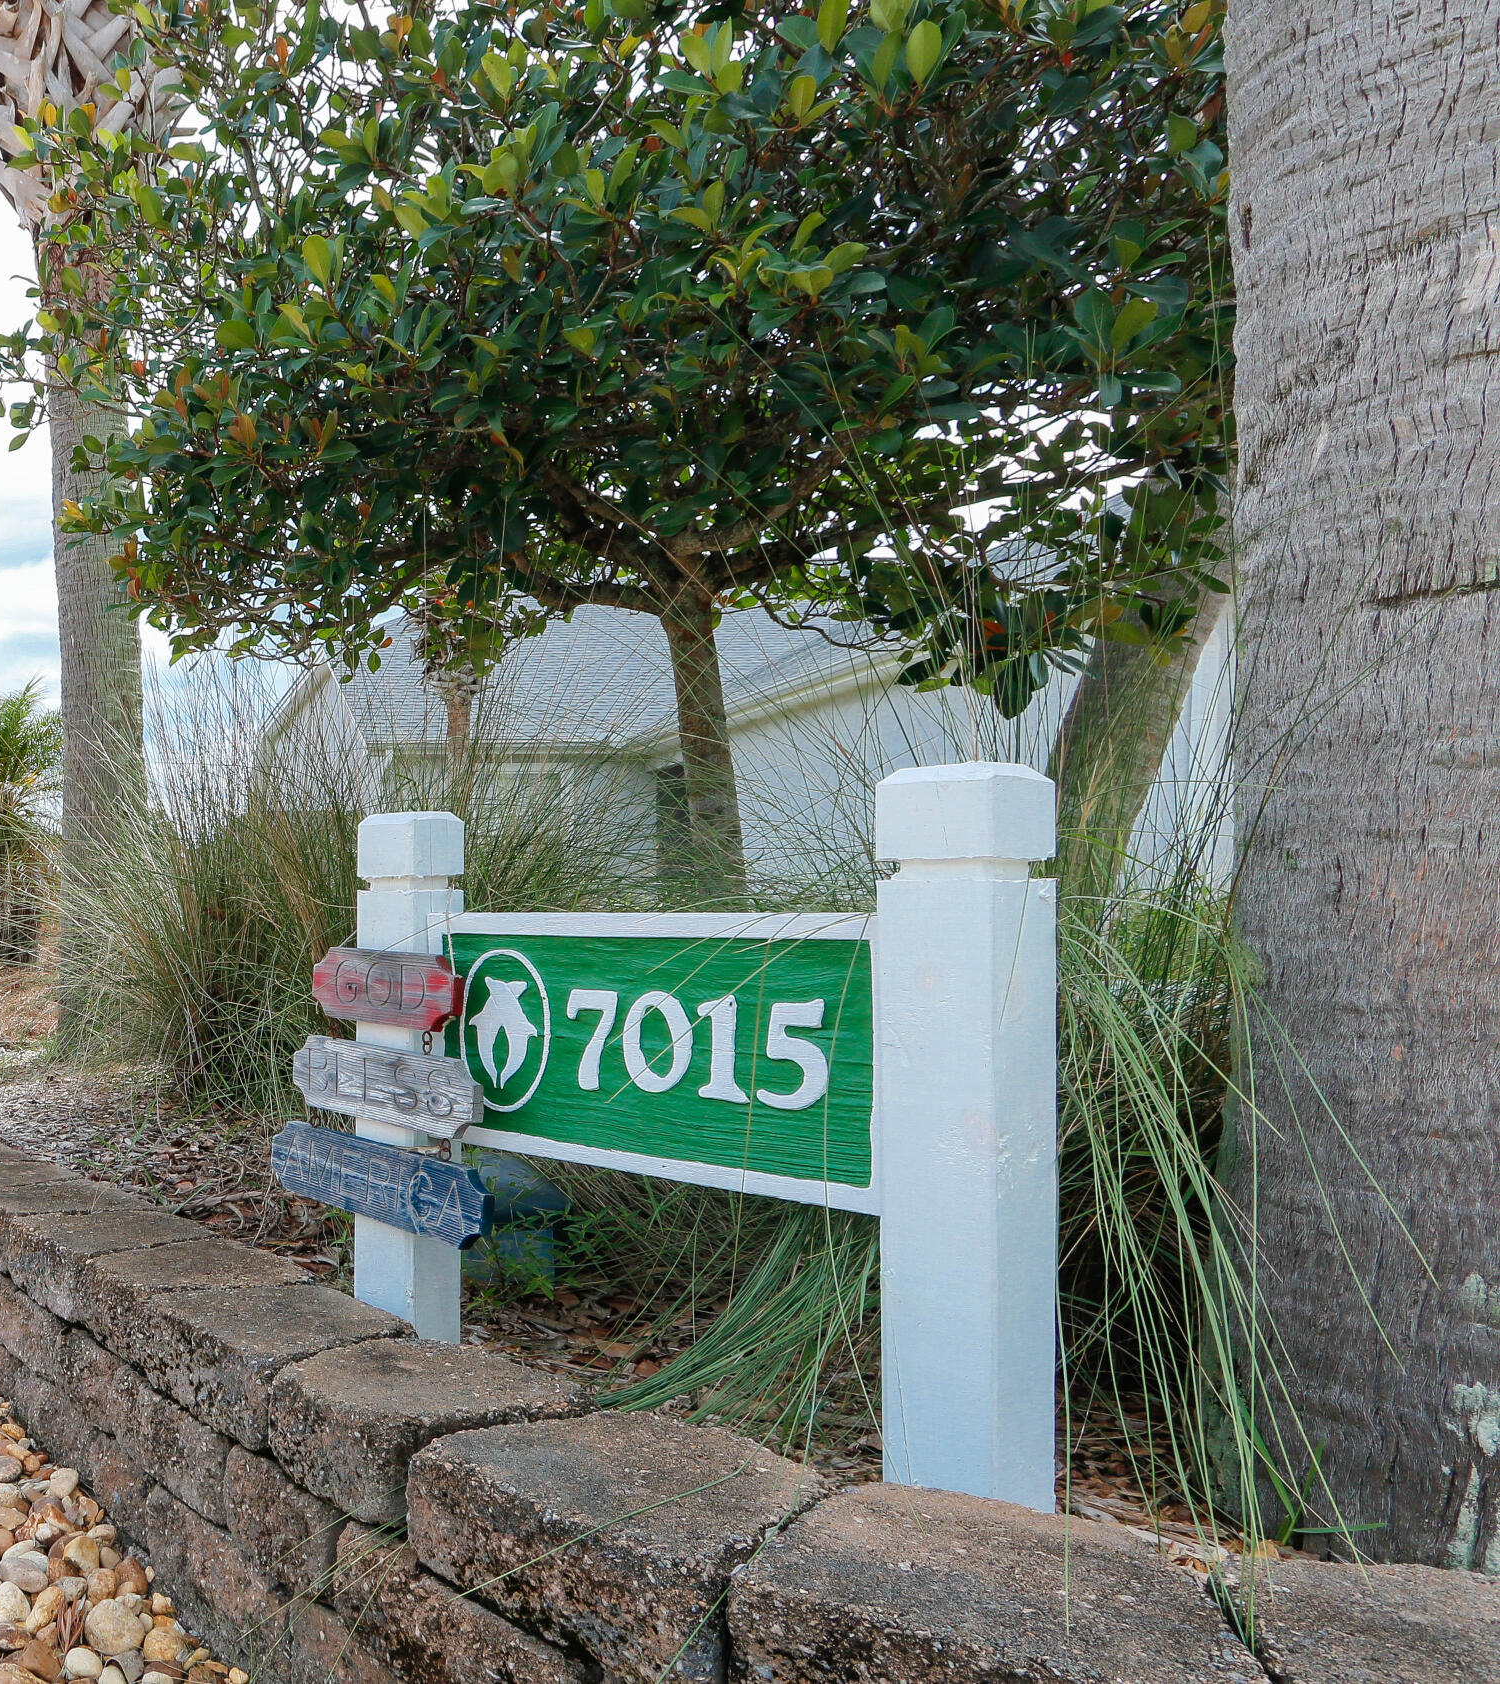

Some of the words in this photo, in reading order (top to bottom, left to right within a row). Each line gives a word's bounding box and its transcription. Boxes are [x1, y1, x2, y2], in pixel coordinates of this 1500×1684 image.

[335, 959, 426, 1011] GOD
[308, 1048, 454, 1118] BLESS
[566, 989, 829, 1109] 7015
[281, 1131, 466, 1234] AMERICA
